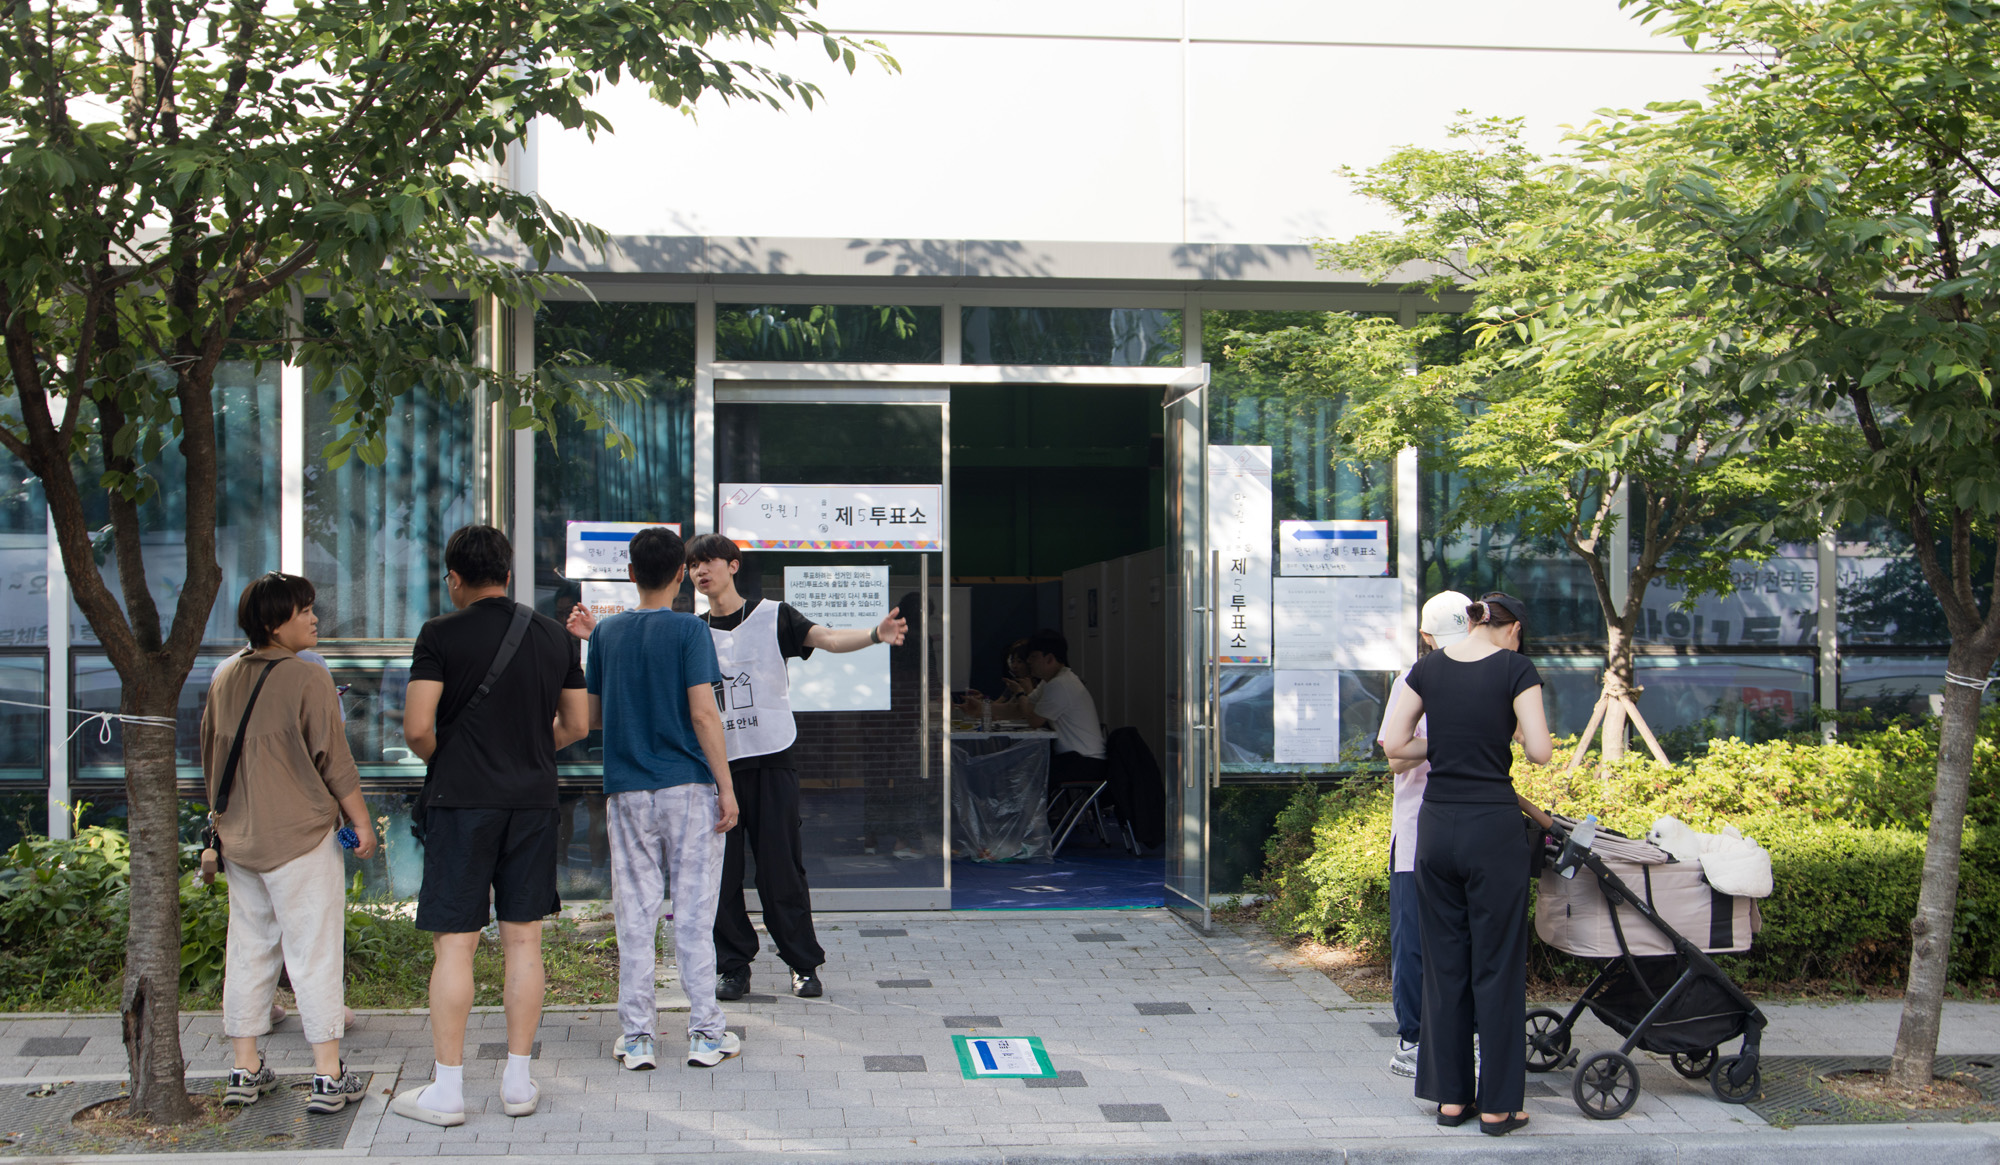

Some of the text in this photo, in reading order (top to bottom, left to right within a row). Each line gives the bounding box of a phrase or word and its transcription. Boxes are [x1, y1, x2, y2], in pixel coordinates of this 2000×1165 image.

[803, 571, 832, 580] 투표하려는
[834, 571, 852, 580] 선거인
[850, 580, 857, 588] 수
[794, 592, 880, 600] 이미 투표한 사람이 다시 투표를
[810, 600, 823, 608] 경우
[849, 600, 856, 608] 수
